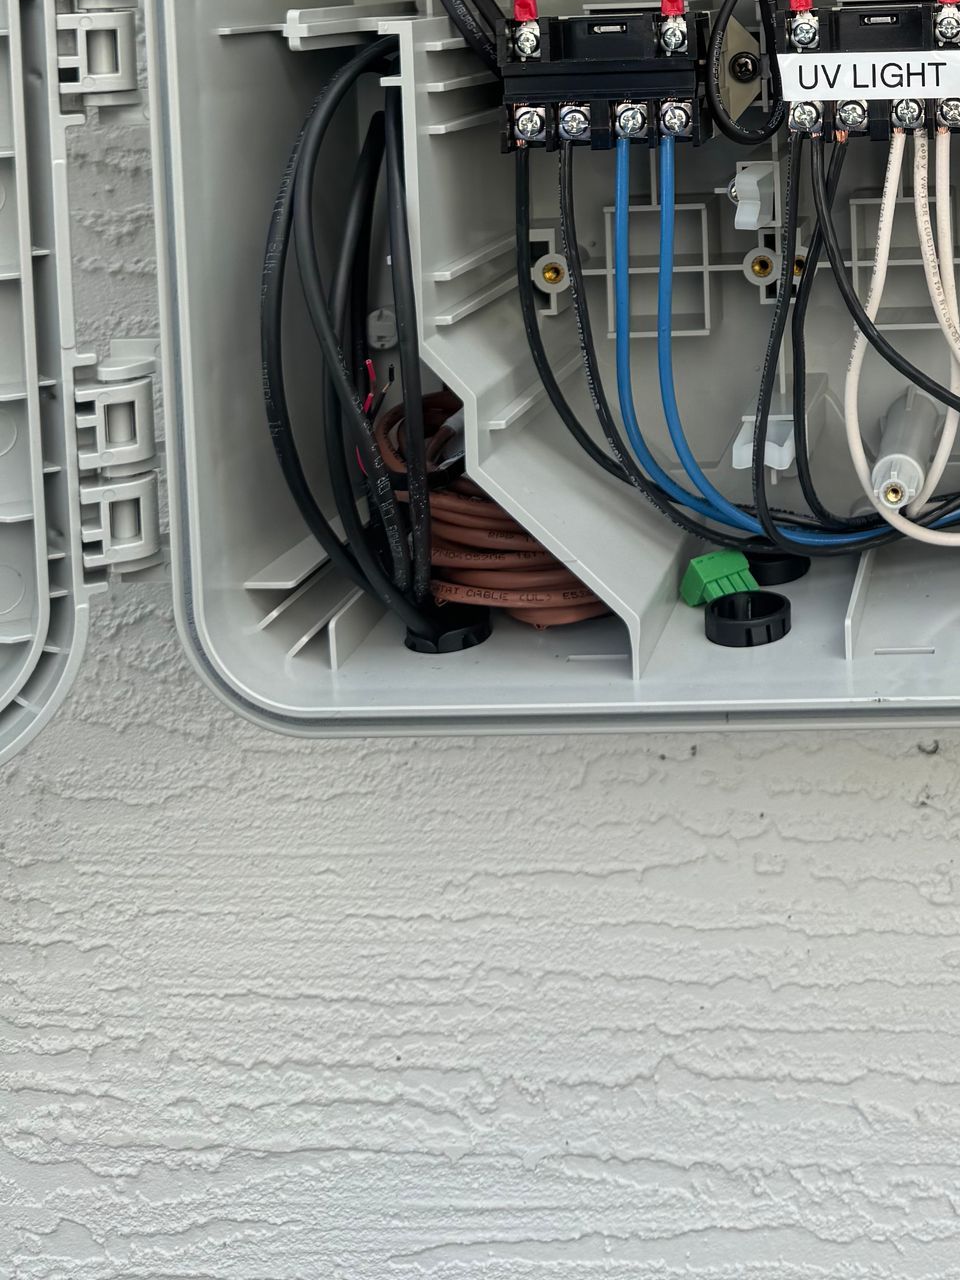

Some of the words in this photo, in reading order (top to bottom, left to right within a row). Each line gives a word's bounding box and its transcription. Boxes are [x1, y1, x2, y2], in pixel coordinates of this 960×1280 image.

[798, 63, 842, 90] UV
[852, 62, 948, 89] LIGHT
[920, 176, 928, 199] VW-1
[466, 589, 509, 601] CABLE
